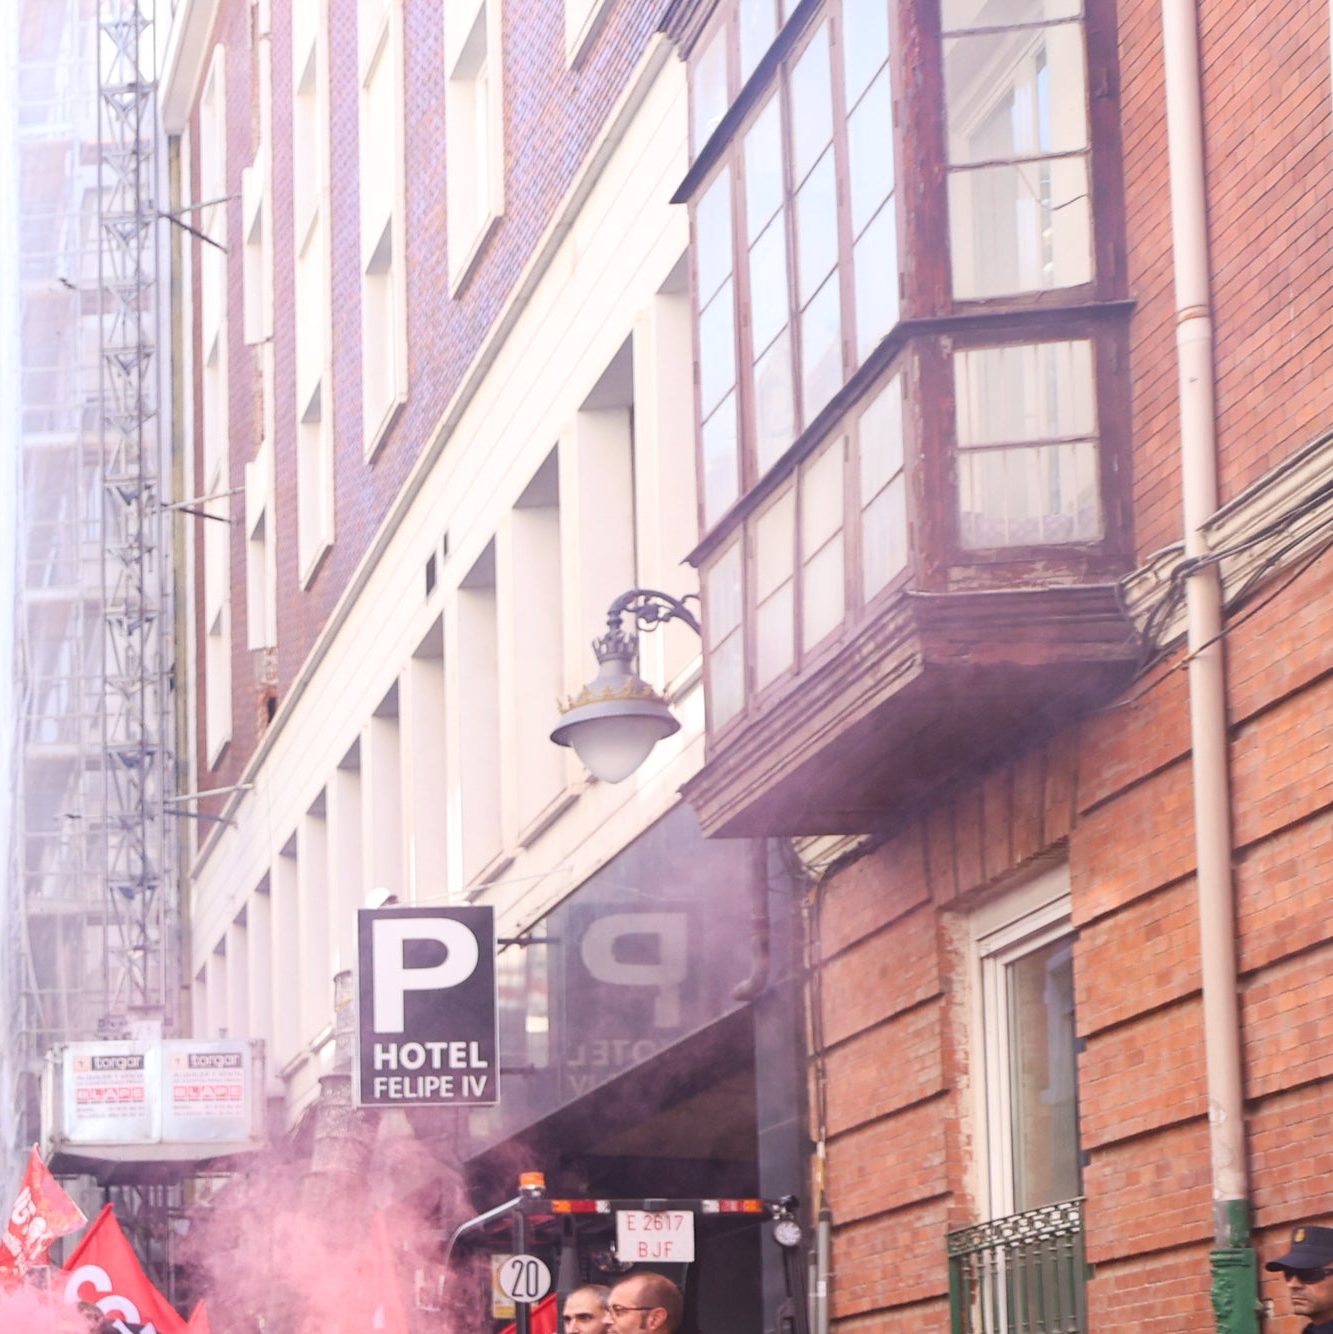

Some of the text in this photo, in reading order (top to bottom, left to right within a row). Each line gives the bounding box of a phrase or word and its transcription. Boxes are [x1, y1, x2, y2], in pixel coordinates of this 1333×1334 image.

[372, 916, 479, 1034] P
[372, 1041, 489, 1071] HOTEL
[373, 1075, 488, 1099] FELIPE IV
[627, 1214, 684, 1231] E 2617
[637, 1241, 674, 1258] BJF
[511, 1259, 539, 1297] 20
